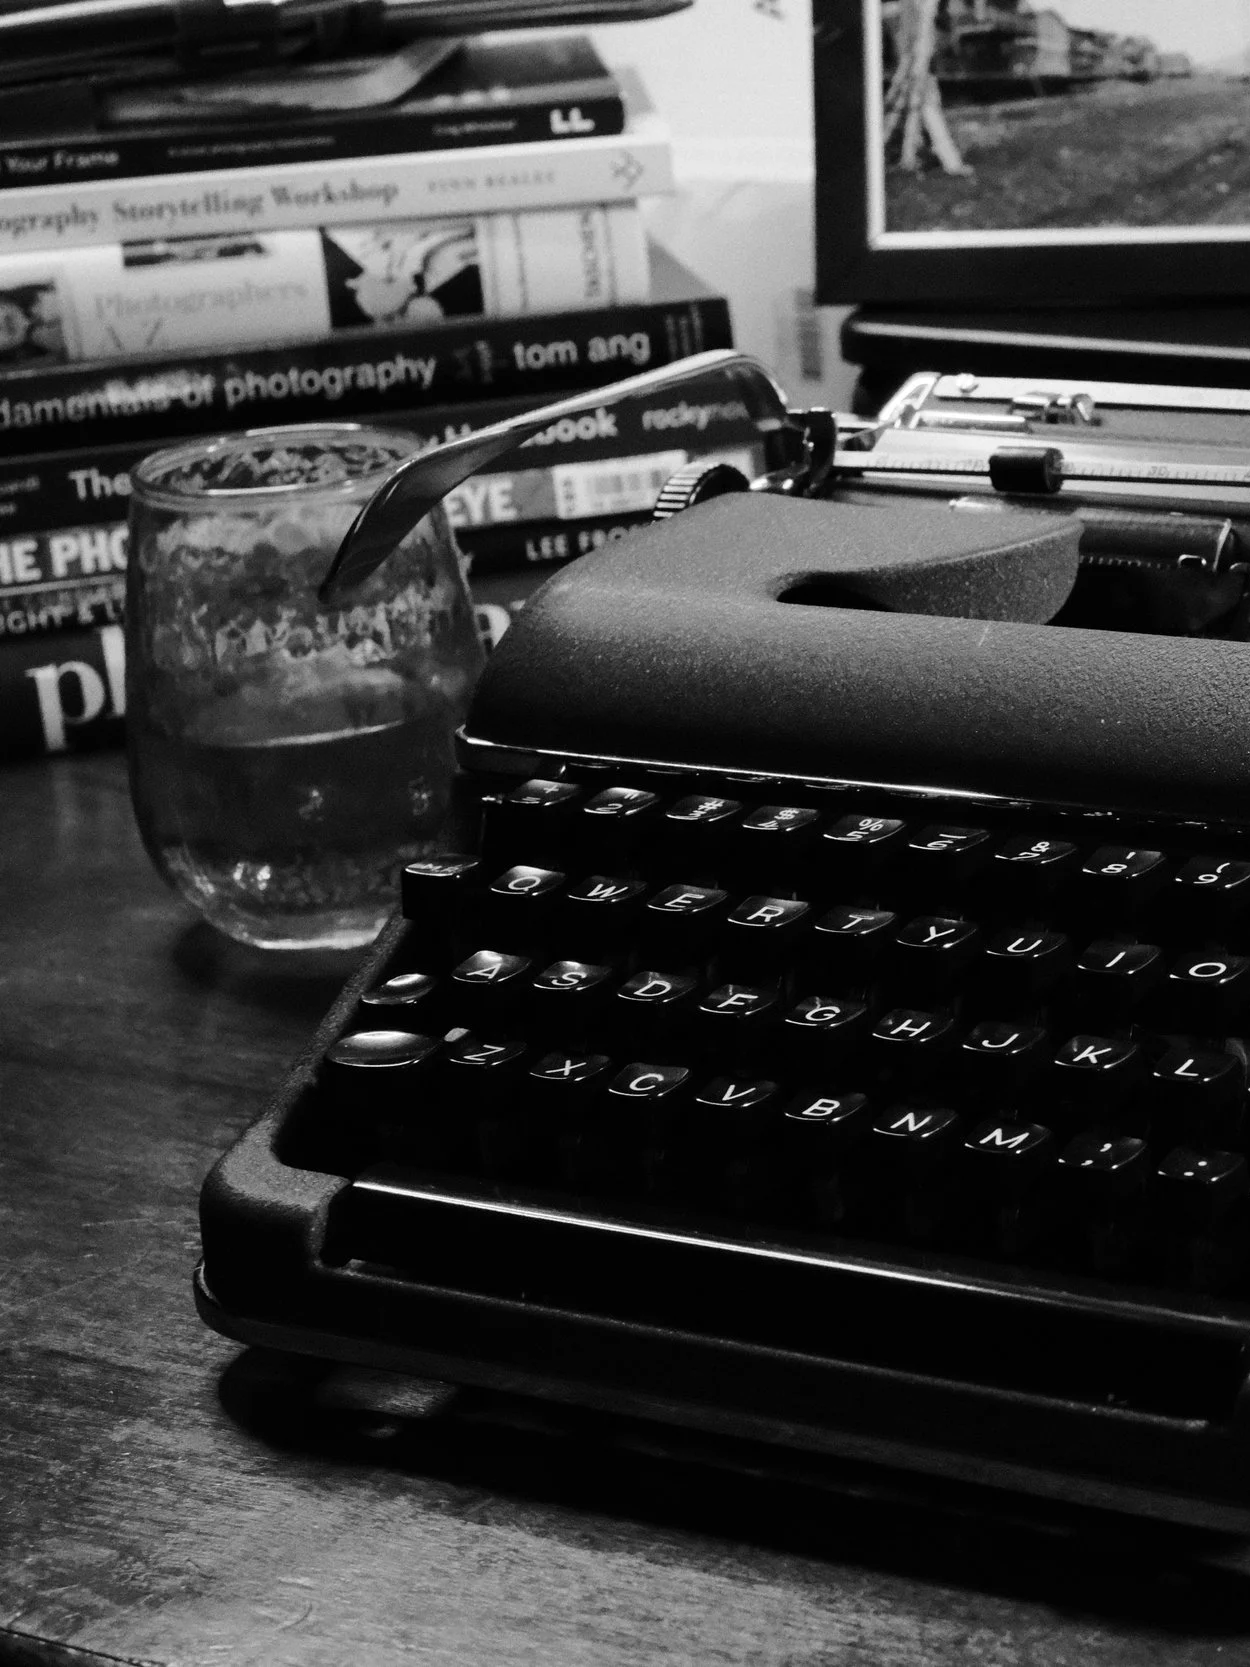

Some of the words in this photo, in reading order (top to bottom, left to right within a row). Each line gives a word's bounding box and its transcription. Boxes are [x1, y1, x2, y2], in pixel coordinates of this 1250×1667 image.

[113, 190, 263, 226] Storytelling
[271, 180, 399, 206] Workshop
[224, 355, 436, 408] photography
[513, 340, 578, 370] tom
[588, 332, 650, 365] ang
[443, 474, 518, 528] EYE
[526, 533, 568, 561] LEE
[596, 803, 623, 815] 2
[776, 808, 798, 821] $
[859, 817, 884, 832] %
[844, 831, 869, 842] 5
[927, 840, 954, 851] 6
[1101, 863, 1128, 874] 8
[508, 876, 541, 894] Q
[1194, 873, 1219, 885] 9
[586, 883, 629, 899] W
[664, 893, 706, 909] E
[746, 905, 783, 923] R
[842, 914, 876, 930] T
[923, 926, 956, 943] Y
[1006, 938, 1043, 953] U
[466, 963, 503, 980] A
[1188, 962, 1228, 978] O
[551, 971, 588, 987] S
[633, 980, 672, 997] D
[716, 993, 759, 1009] F
[804, 1005, 842, 1022] G
[890, 1018, 932, 1038] H
[981, 1033, 1020, 1049] J
[463, 1044, 506, 1062] Z
[1073, 1046, 1113, 1064] K
[545, 1059, 587, 1077] X
[1174, 1058, 1199, 1077] L
[628, 1072, 665, 1091] C
[721, 1084, 757, 1102] V
[801, 1098, 841, 1117] B
[890, 1112, 933, 1132] N
[979, 1127, 1030, 1149] M
